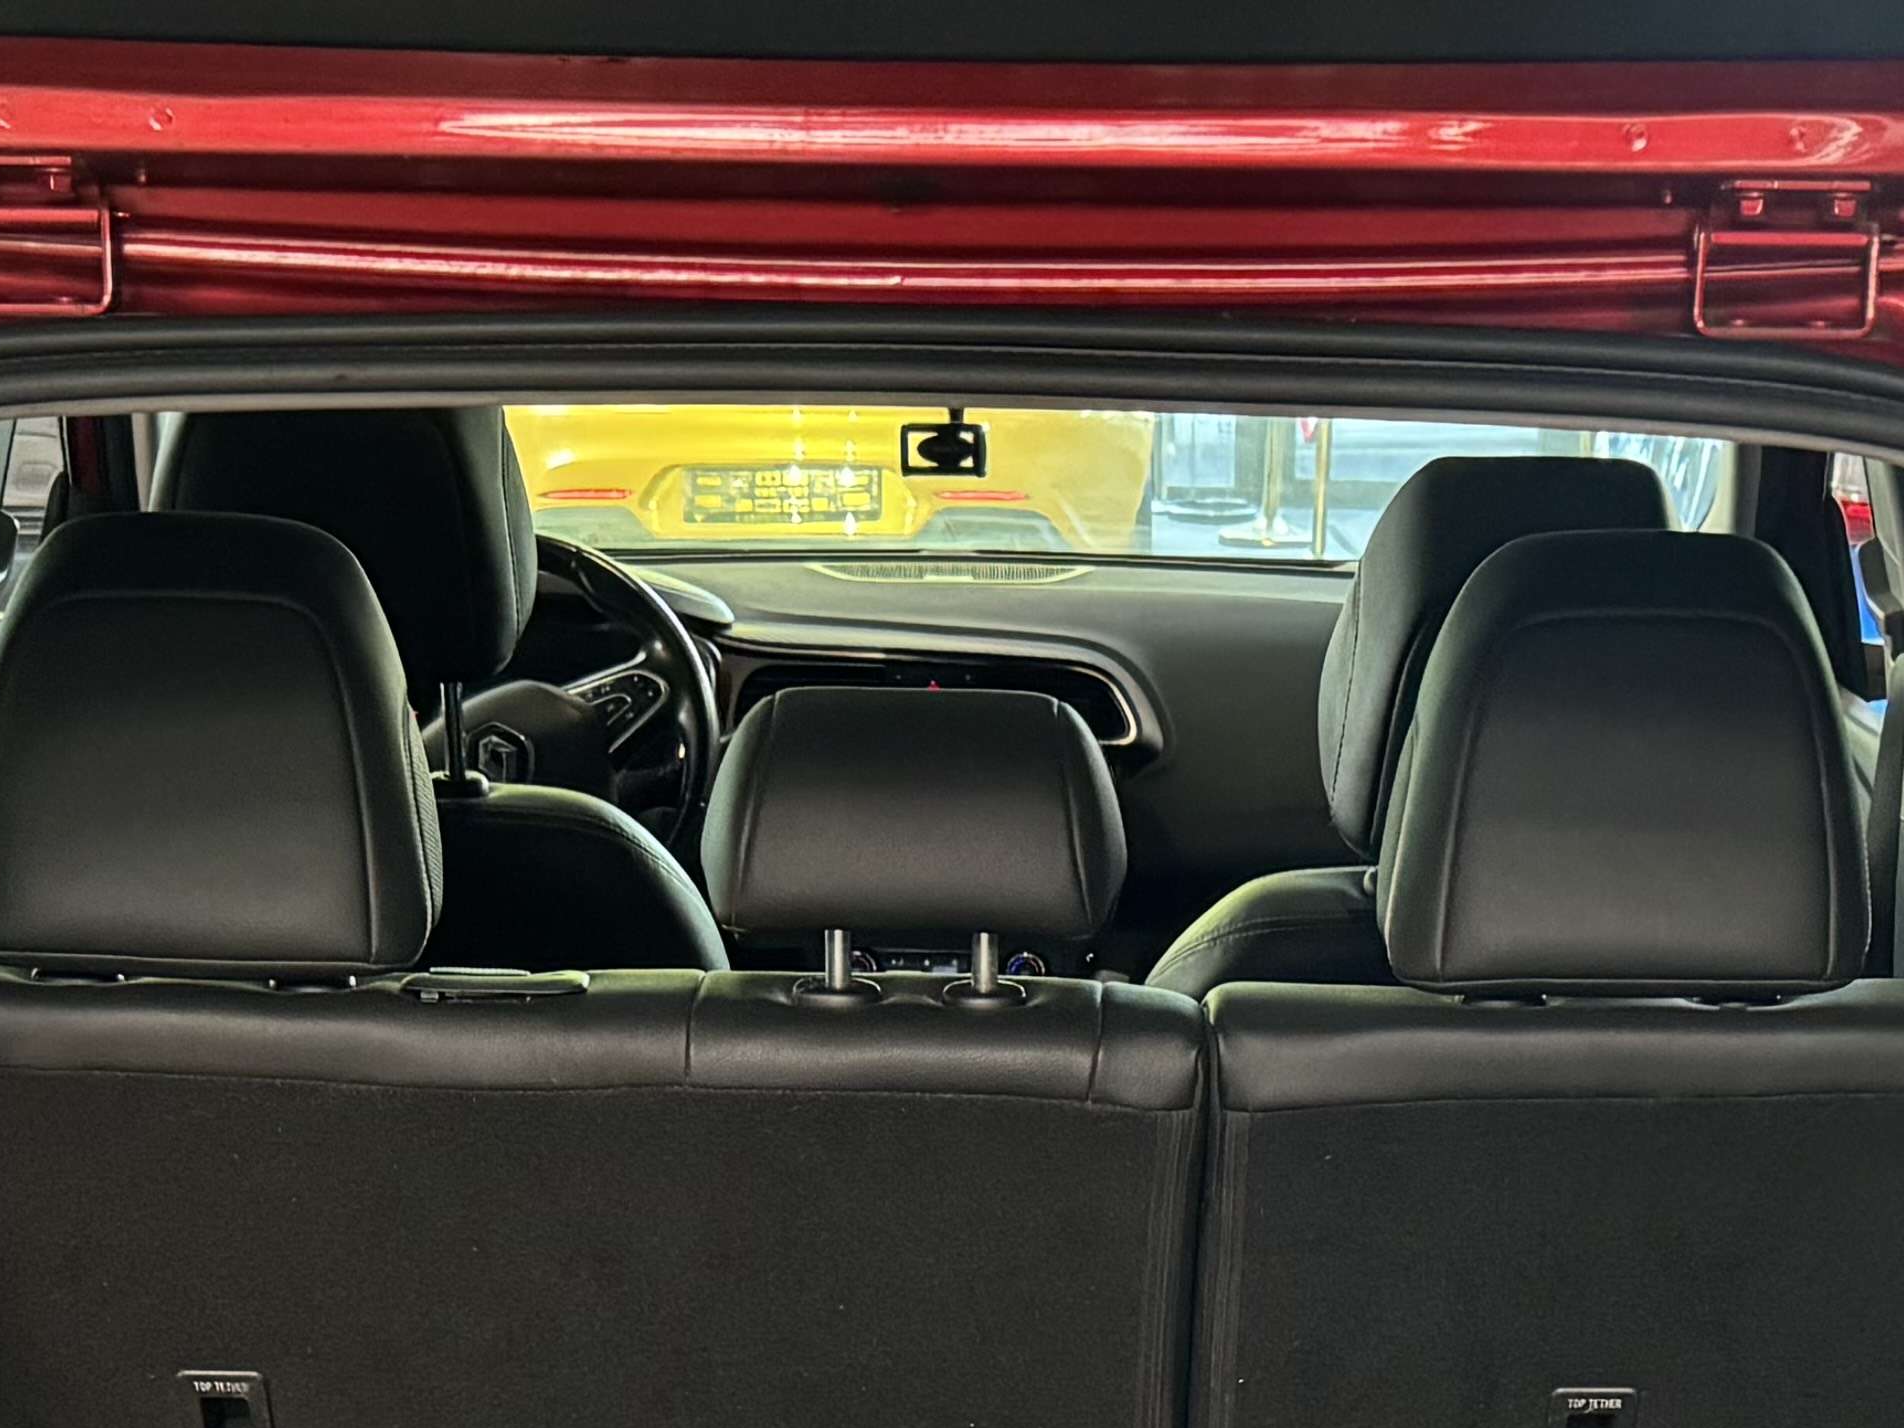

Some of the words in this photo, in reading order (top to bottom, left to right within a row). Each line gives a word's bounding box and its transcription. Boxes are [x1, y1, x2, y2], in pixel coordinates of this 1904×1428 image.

[193, 1381, 213, 1392] TOP
[1568, 1398, 1587, 1409] TOP
[1588, 1398, 1622, 1409] TETHER
